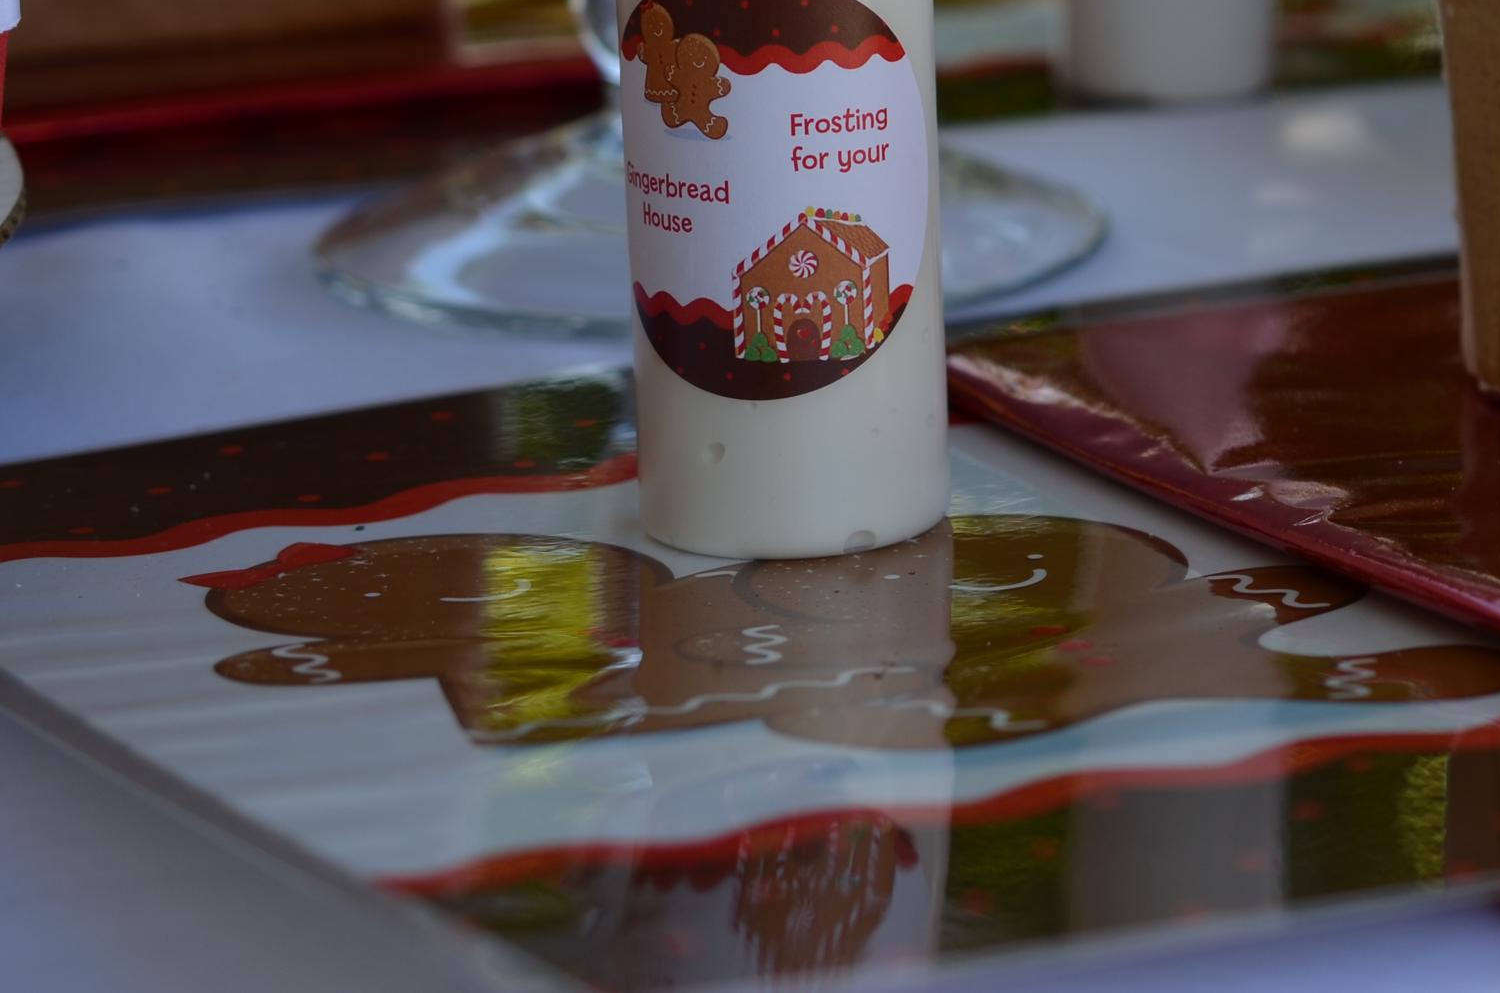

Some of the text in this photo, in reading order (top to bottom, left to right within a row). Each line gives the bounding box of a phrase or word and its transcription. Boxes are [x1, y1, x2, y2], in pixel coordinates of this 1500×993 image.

[790, 108, 888, 136] Frosting
[791, 143, 889, 173] for your
[642, 201, 693, 233] House
